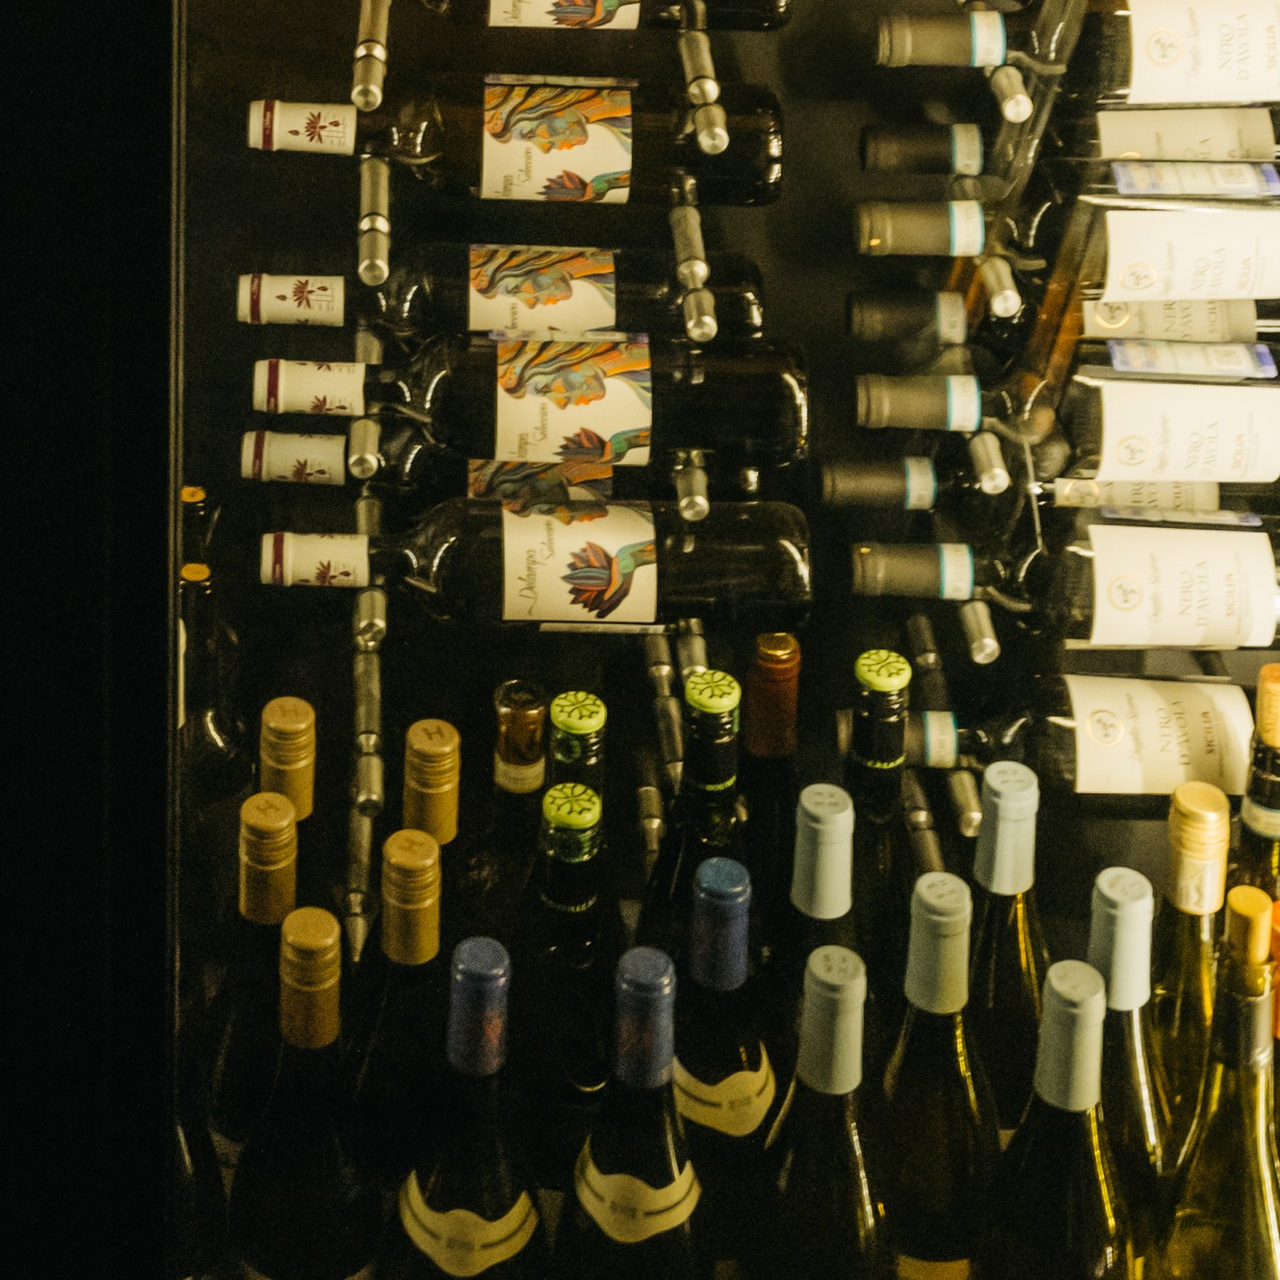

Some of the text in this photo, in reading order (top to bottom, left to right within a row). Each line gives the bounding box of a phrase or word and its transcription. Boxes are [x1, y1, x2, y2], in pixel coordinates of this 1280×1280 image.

[1219, 23, 1234, 71] NERO
[1178, 570, 1196, 617] NERO
[1195, 560, 1210, 627] D'AVOLA
[1156, 706, 1171, 753] NERO
